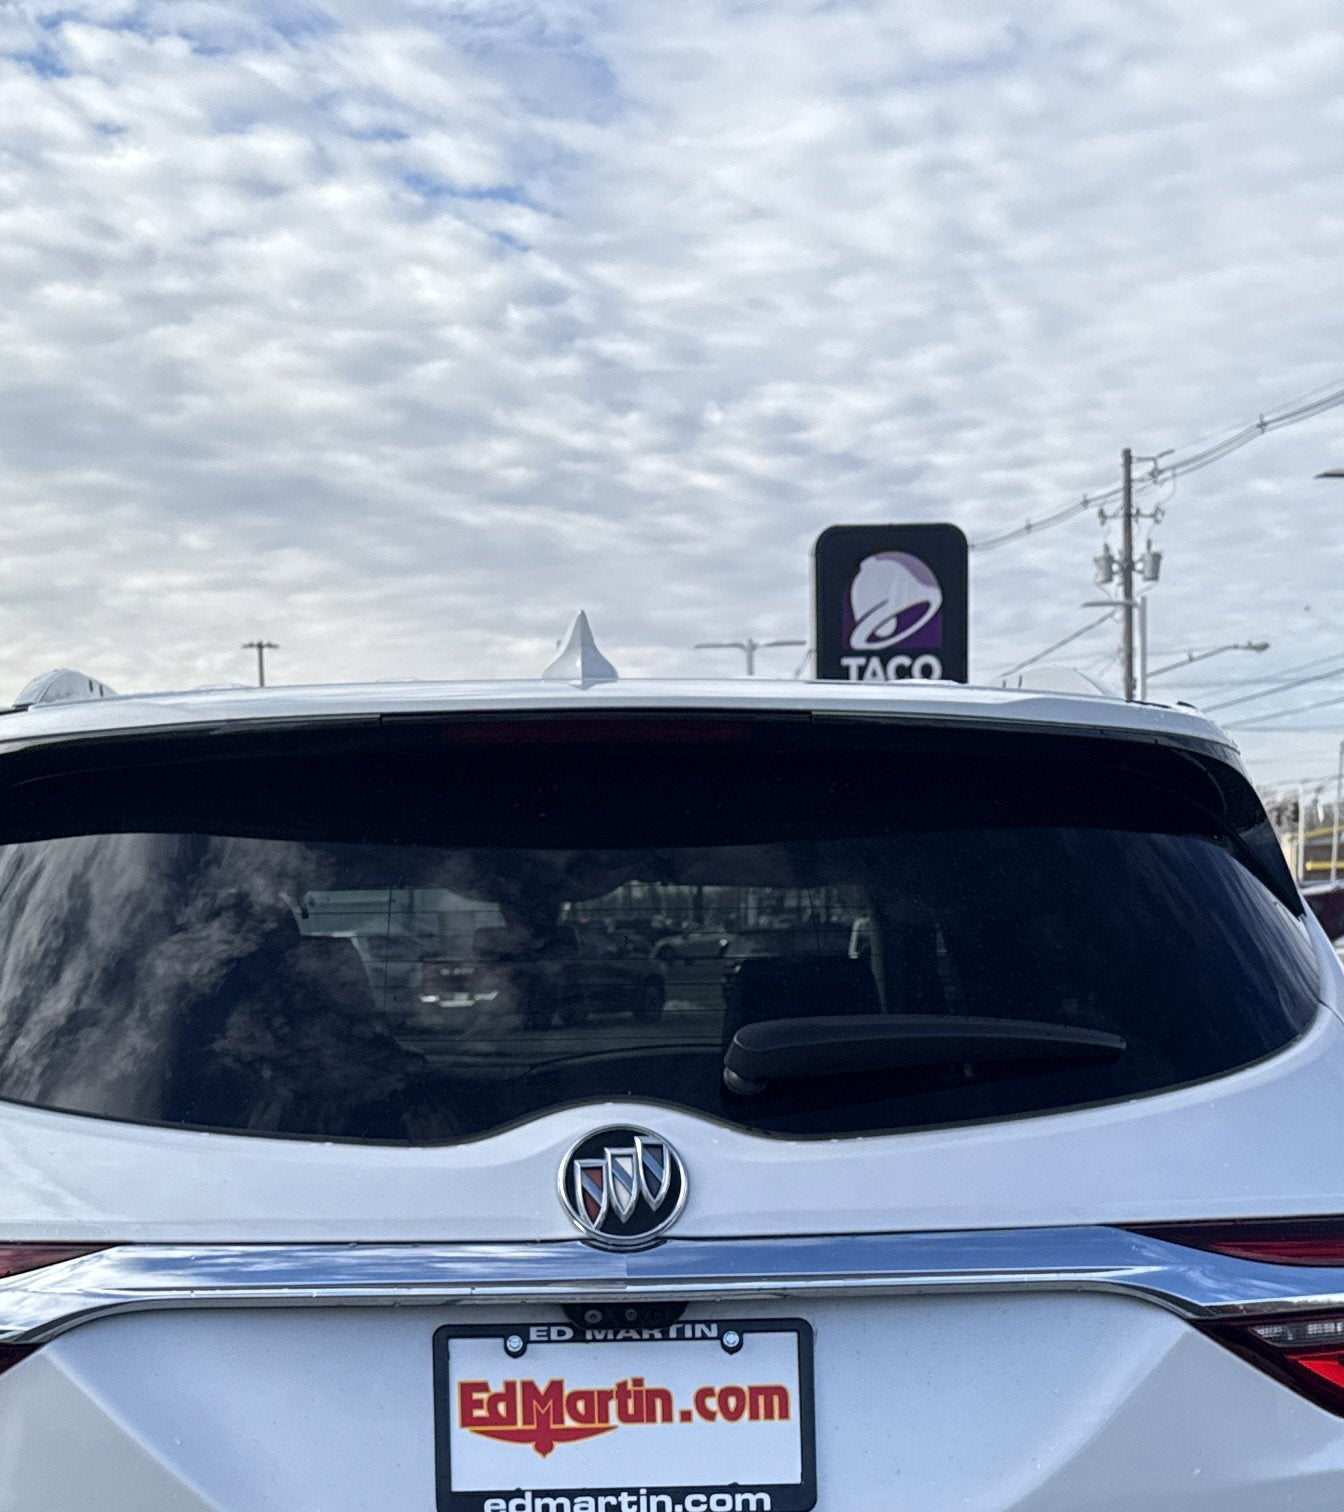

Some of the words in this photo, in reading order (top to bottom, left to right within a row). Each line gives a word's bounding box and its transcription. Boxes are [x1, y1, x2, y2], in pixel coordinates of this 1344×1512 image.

[840, 655, 943, 681] TACO
[529, 1326, 574, 1341] ED
[585, 1323, 719, 1341] MARTIN
[457, 1377, 791, 1442] EdMartin.com
